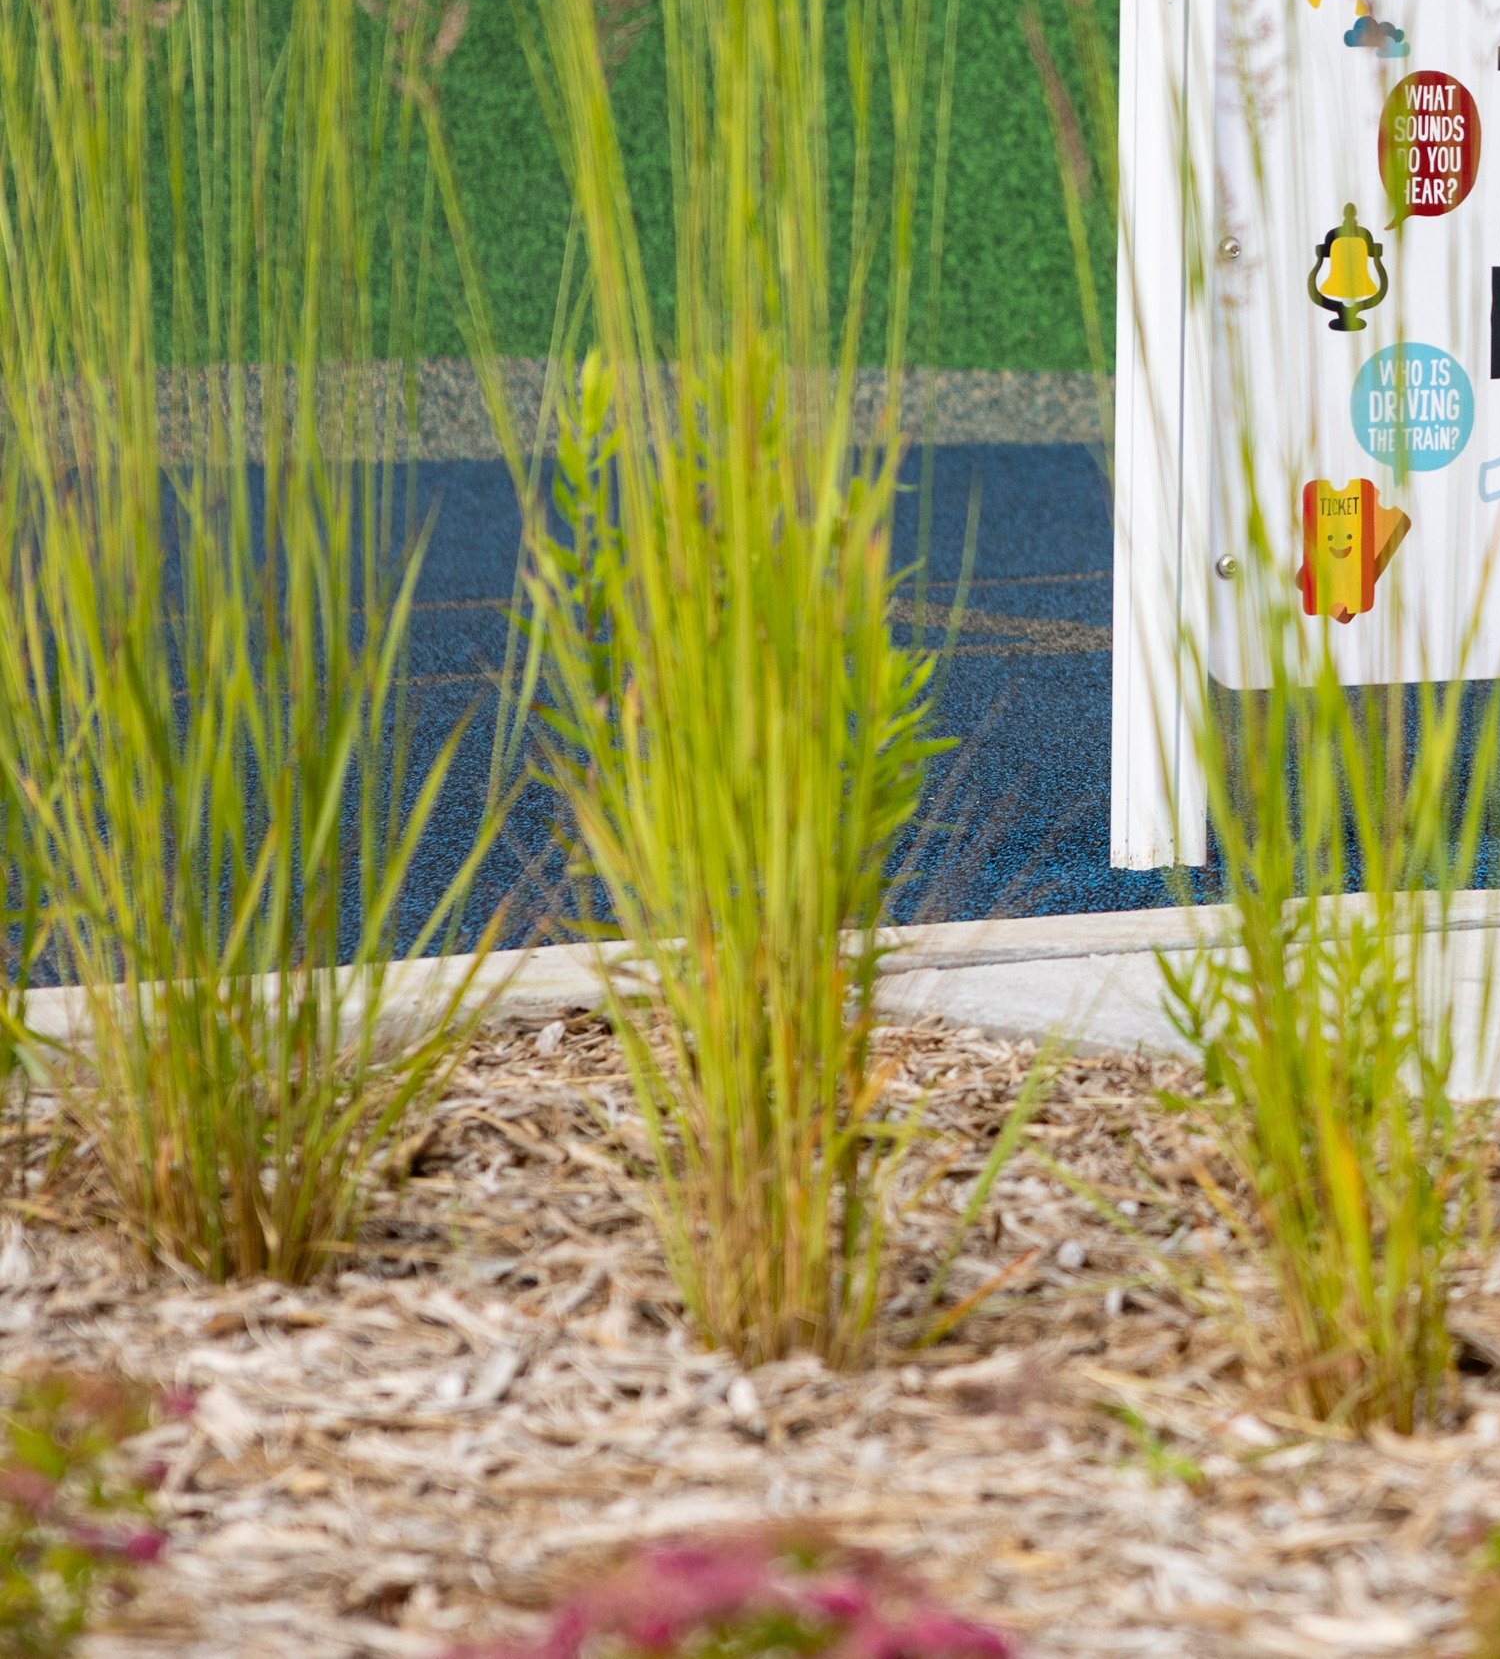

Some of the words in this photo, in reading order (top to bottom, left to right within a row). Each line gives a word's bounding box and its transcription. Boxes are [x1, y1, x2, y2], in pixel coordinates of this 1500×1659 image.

[1405, 85, 1456, 111] WHAT
[1394, 115, 1465, 142] SOUNDS
[1427, 146, 1461, 173] YOU
[1379, 359, 1422, 387] WHO
[1430, 358, 1451, 386] IS
[1368, 428, 1396, 452] THE
[1320, 496, 1359, 516] TICKET
